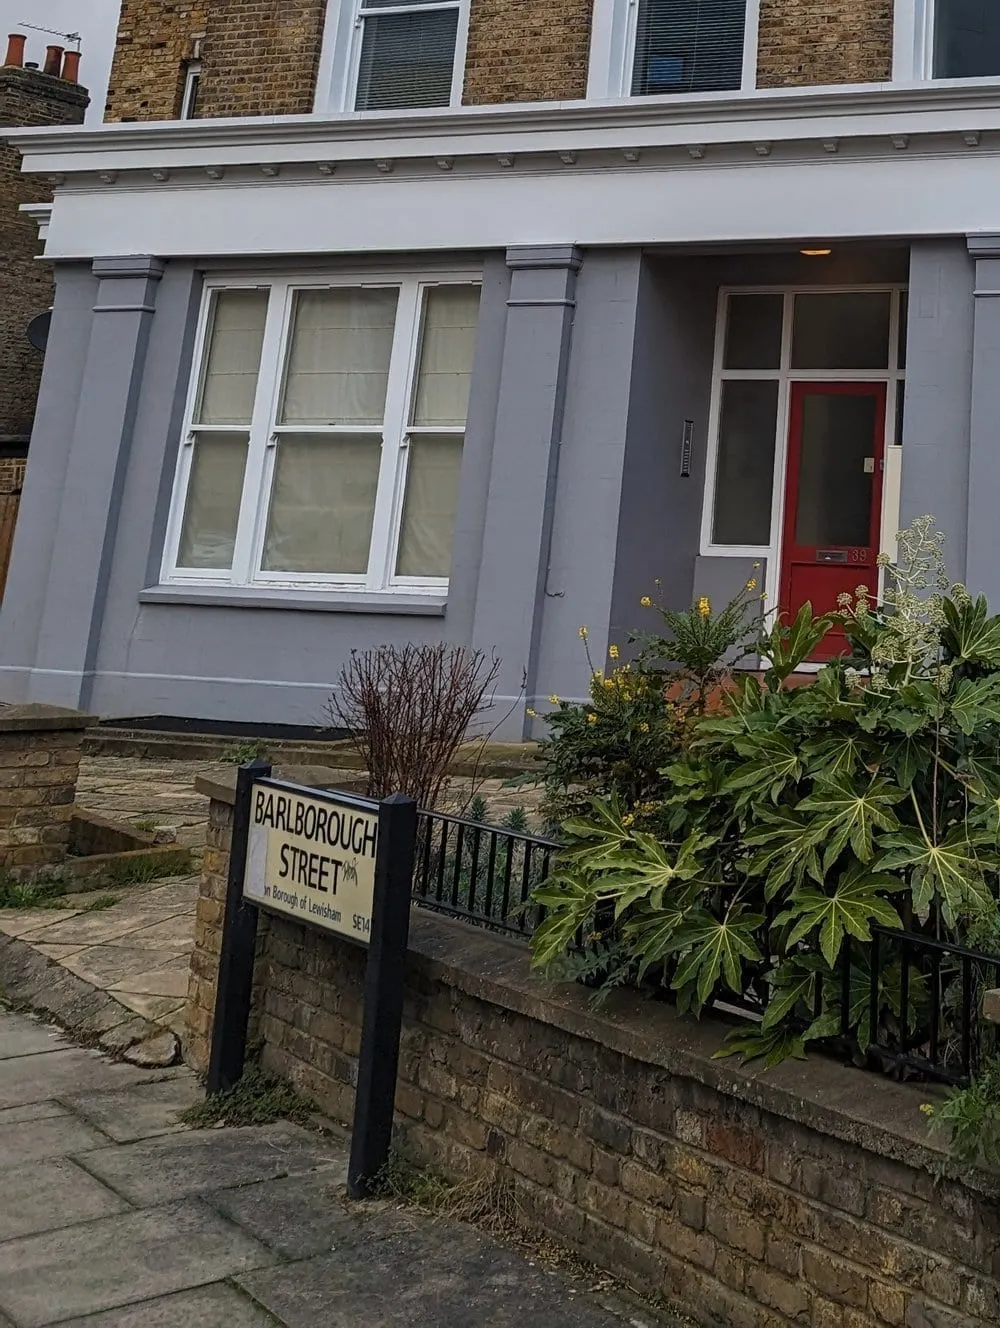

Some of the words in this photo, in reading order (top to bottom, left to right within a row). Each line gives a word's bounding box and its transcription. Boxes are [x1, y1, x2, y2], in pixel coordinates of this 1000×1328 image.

[852, 549, 866, 561] 39
[255, 790, 377, 858] BARLBOROUGH
[279, 843, 342, 895] STREET
[272, 885, 299, 909] Borough
[299, 897, 307, 910] of
[308, 898, 342, 923] Lewisham
[352, 914, 370, 933] SE14
